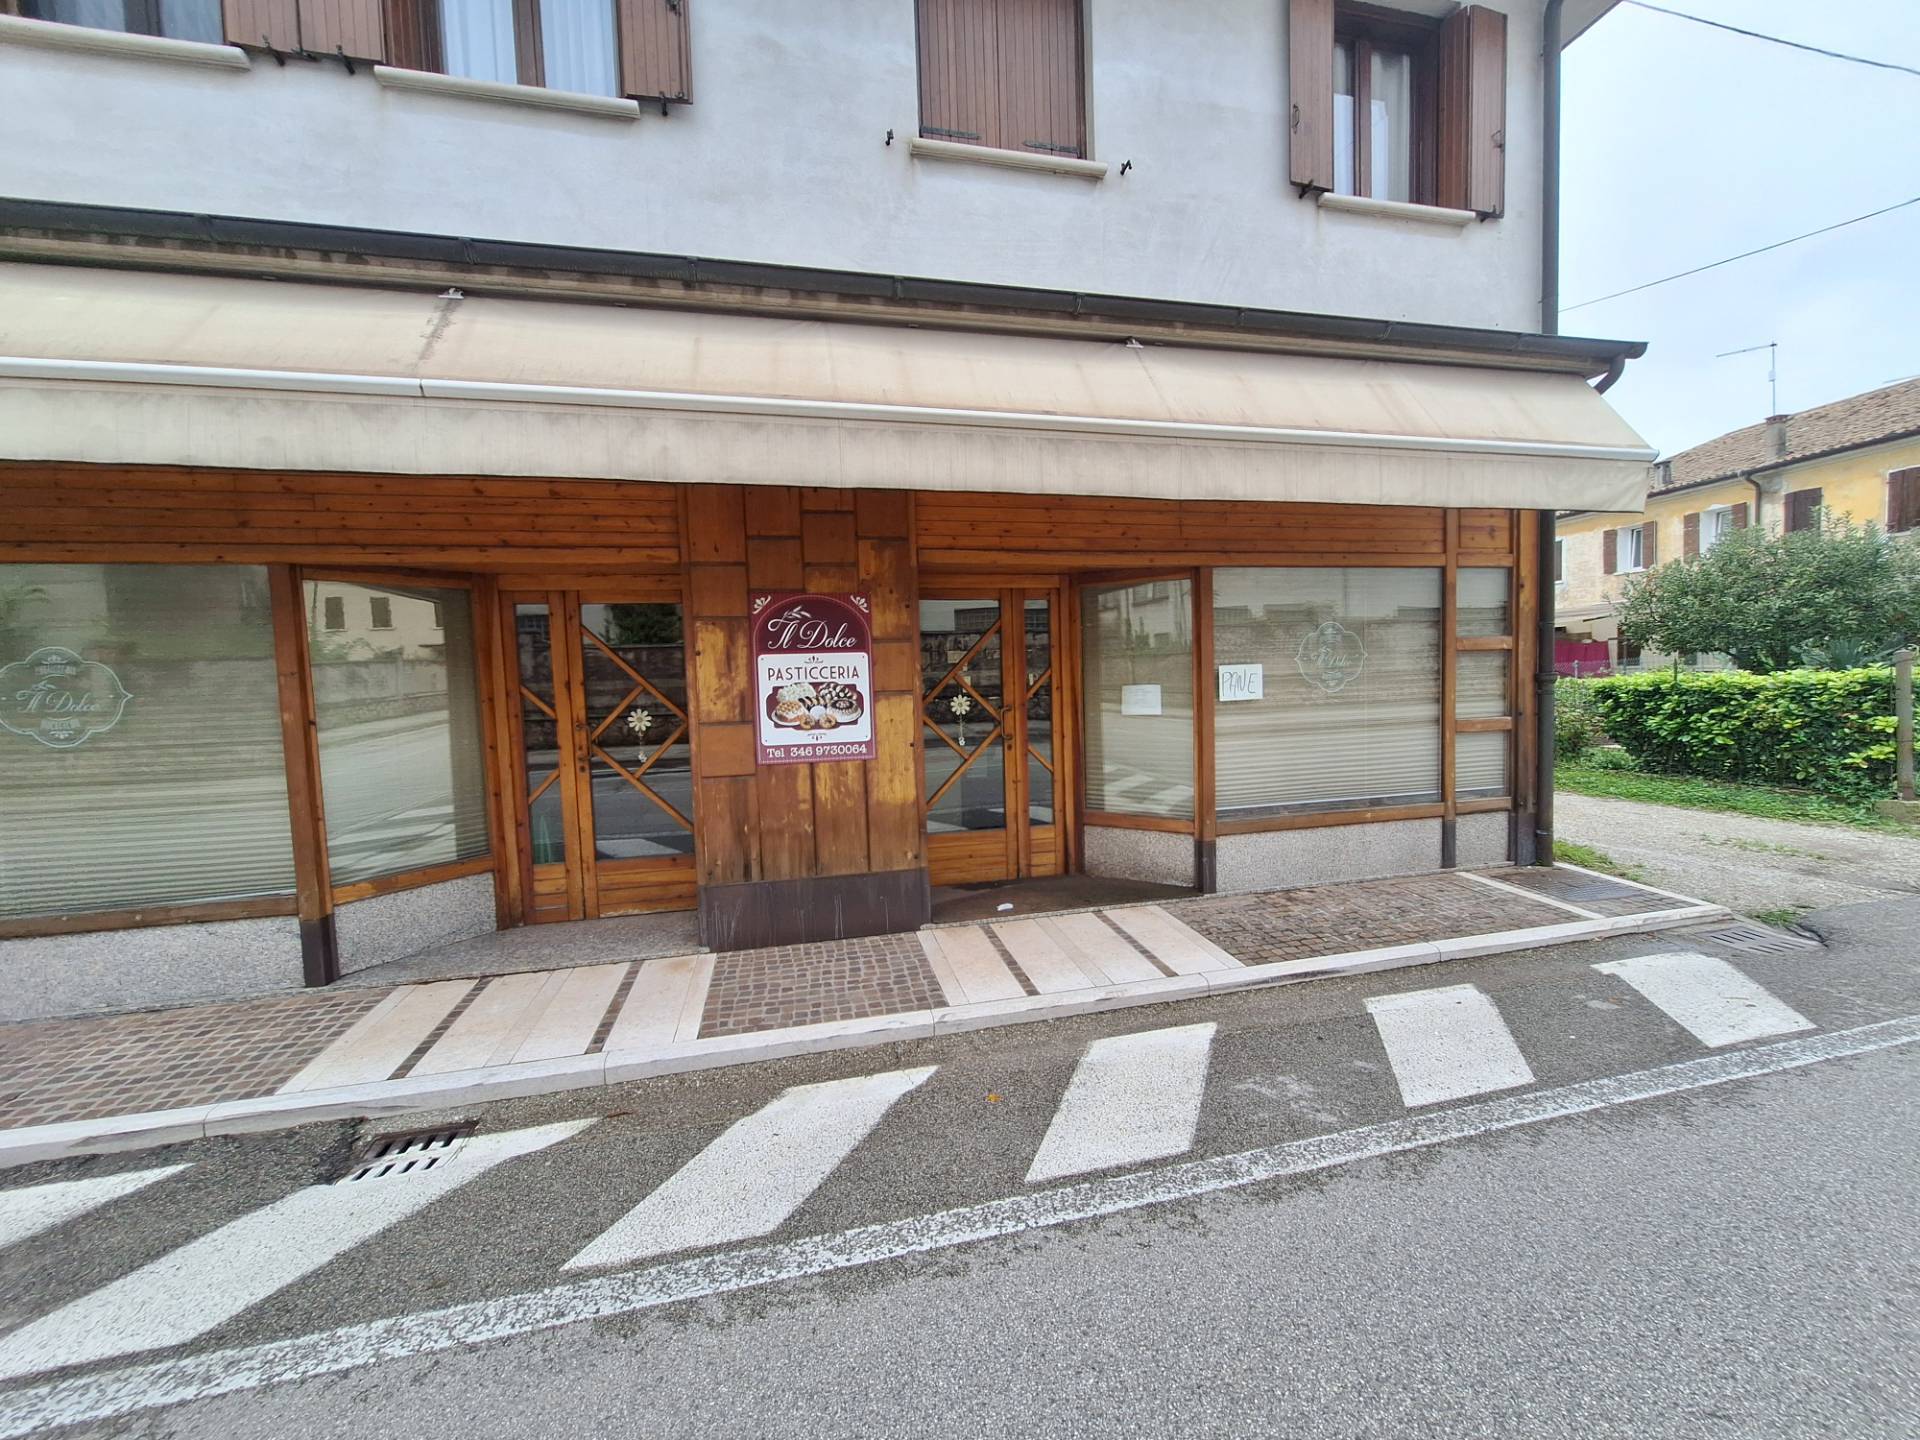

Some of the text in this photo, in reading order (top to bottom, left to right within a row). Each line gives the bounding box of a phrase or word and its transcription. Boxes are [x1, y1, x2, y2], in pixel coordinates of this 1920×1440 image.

[768, 617, 857, 649] Il Dolce
[767, 666, 860, 681] PASTICCERIA
[1221, 669, 1258, 697] PANE
[46, 691, 98, 712] Dolce
[767, 744, 867, 758] Tel 346 9730064
